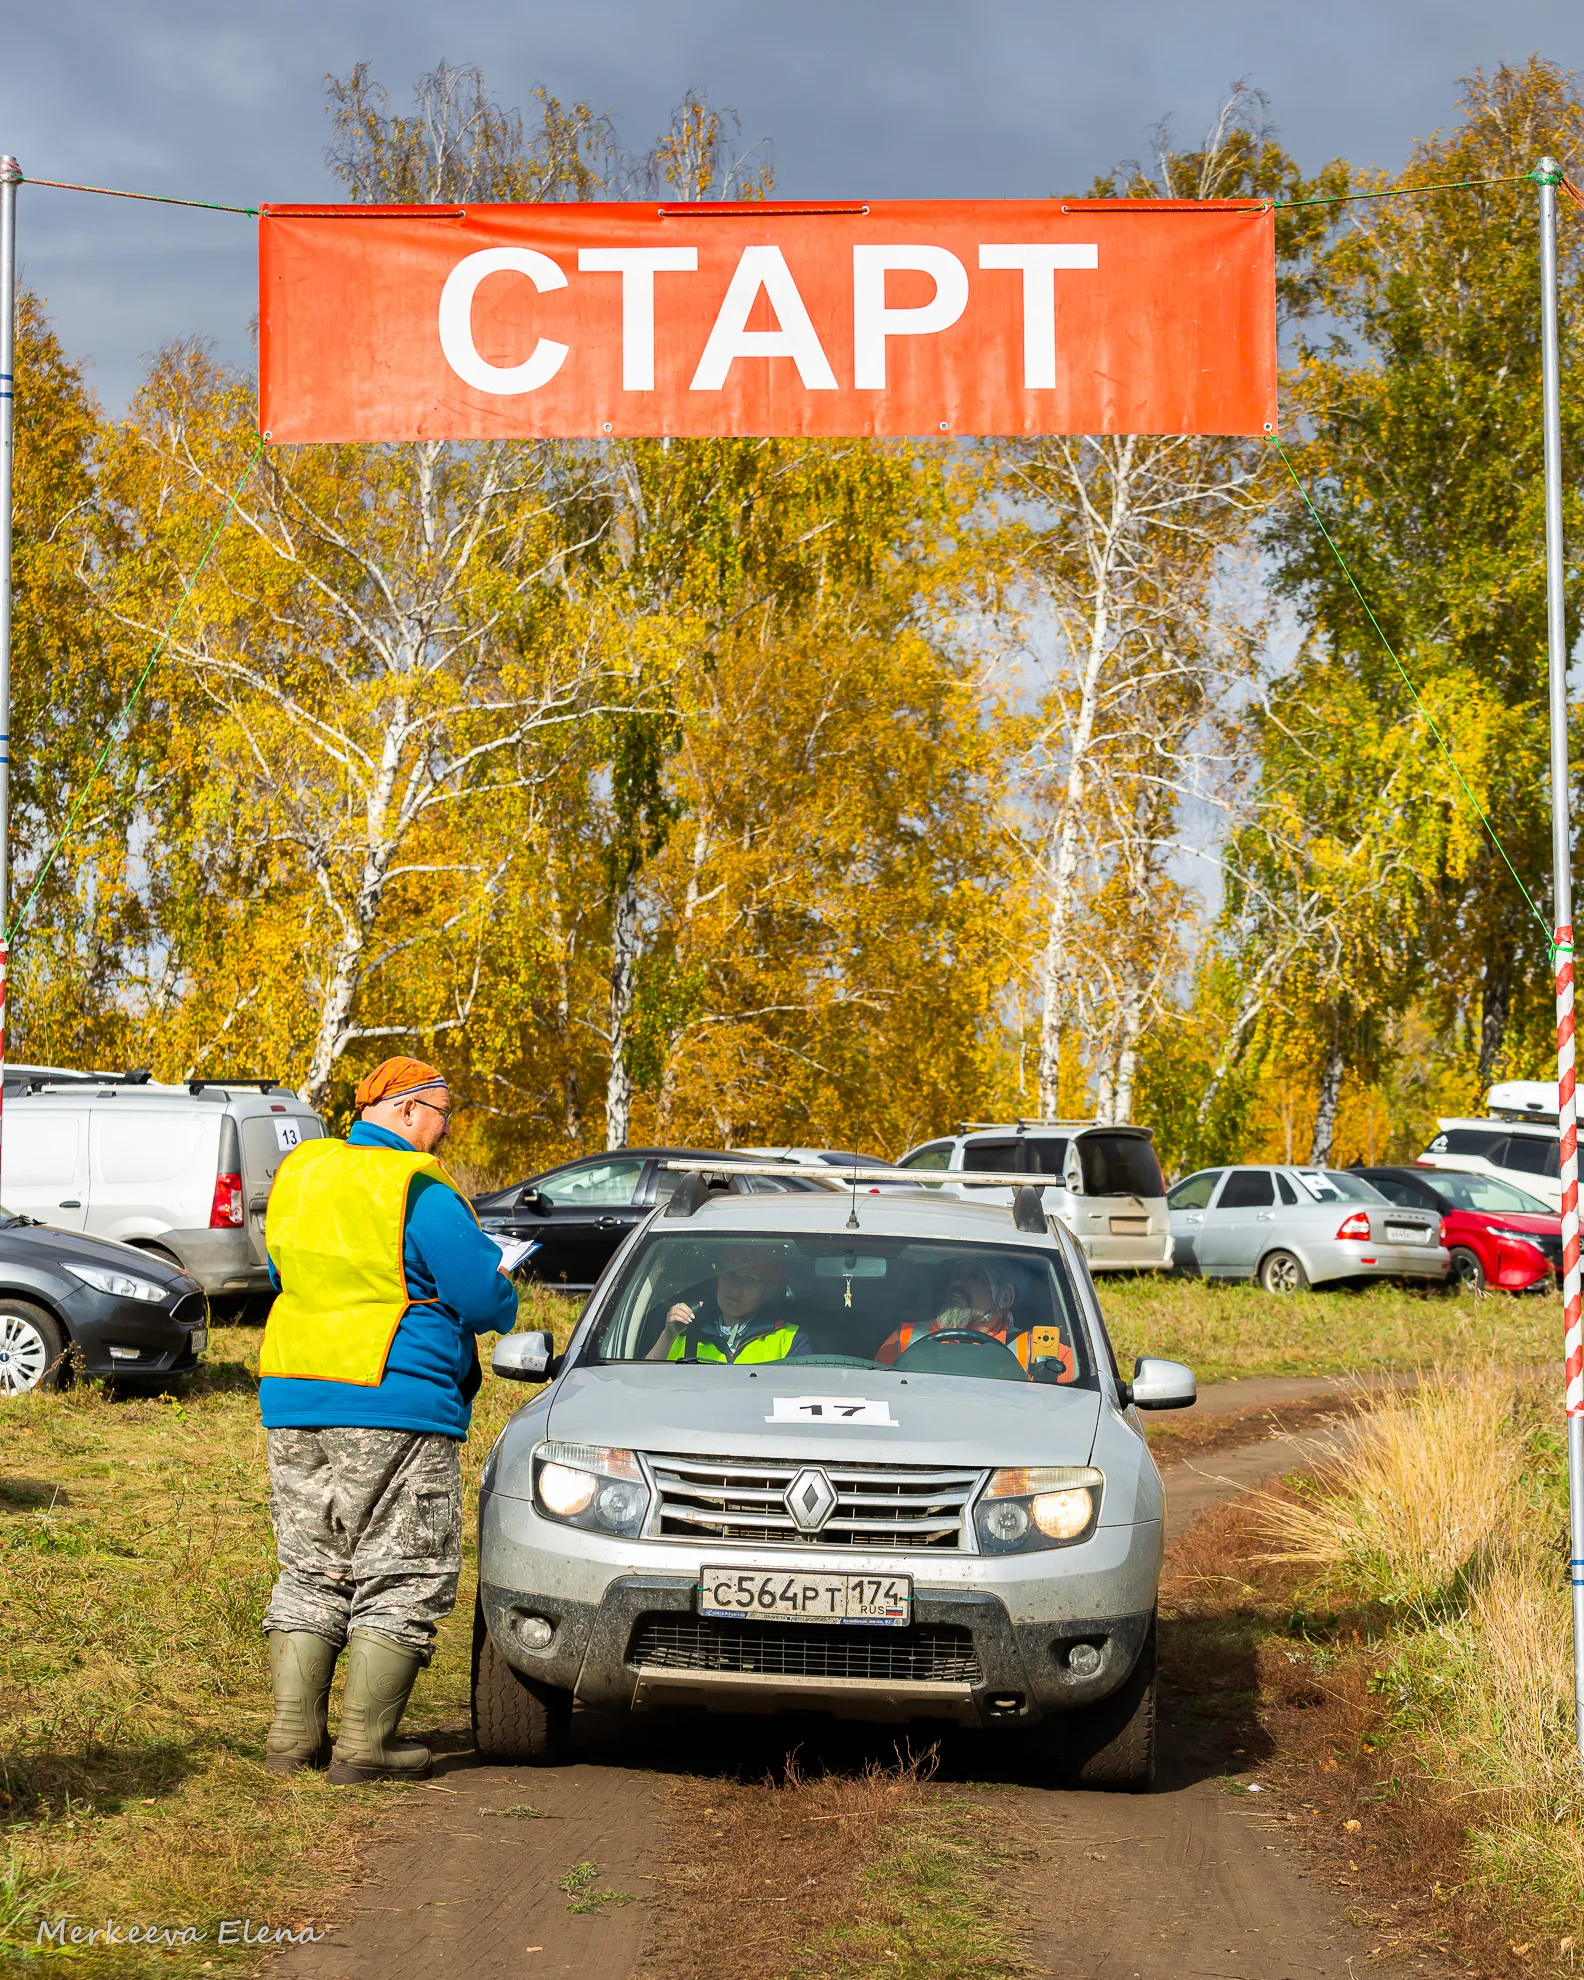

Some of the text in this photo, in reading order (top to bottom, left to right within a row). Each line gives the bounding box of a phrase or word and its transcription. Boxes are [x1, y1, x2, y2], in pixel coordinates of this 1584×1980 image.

[437, 243, 1099, 396] СТАРТ
[282, 1129, 297, 1145] 13
[799, 1404, 866, 1417] 17
[851, 1579, 899, 1606] 174
[860, 1605, 885, 1615] RUS
